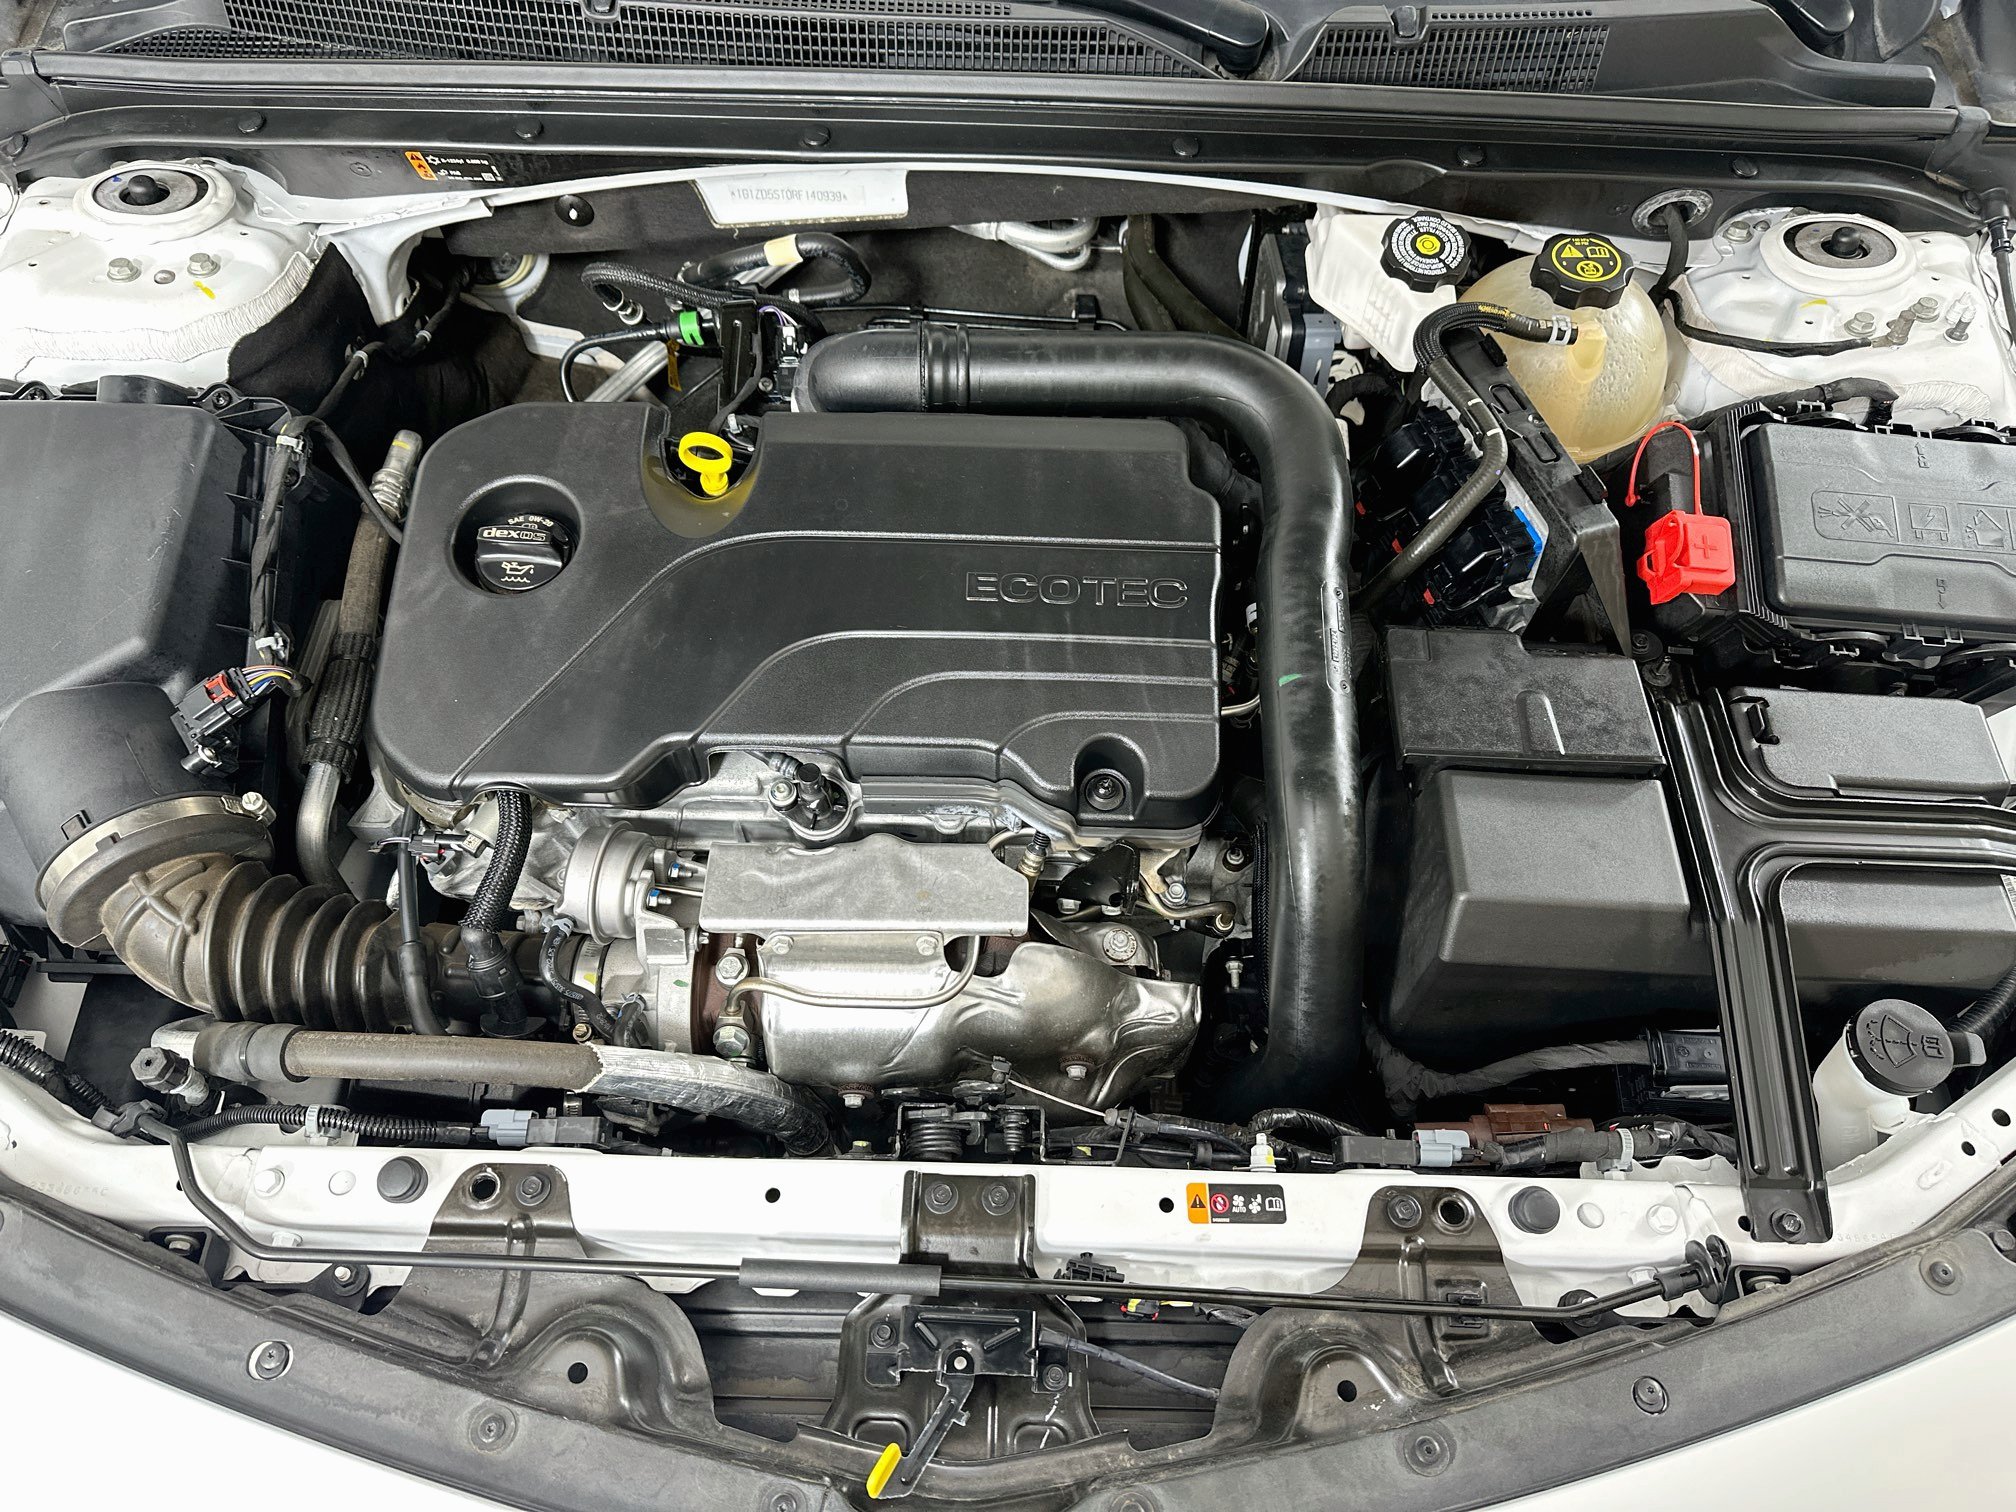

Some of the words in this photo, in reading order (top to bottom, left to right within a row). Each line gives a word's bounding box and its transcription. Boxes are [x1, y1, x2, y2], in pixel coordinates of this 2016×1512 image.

[508, 516, 525, 524] SAE
[528, 515, 554, 527] 0W-20
[483, 528, 546, 541] dexos
[965, 571, 1189, 609] ECOTEC
